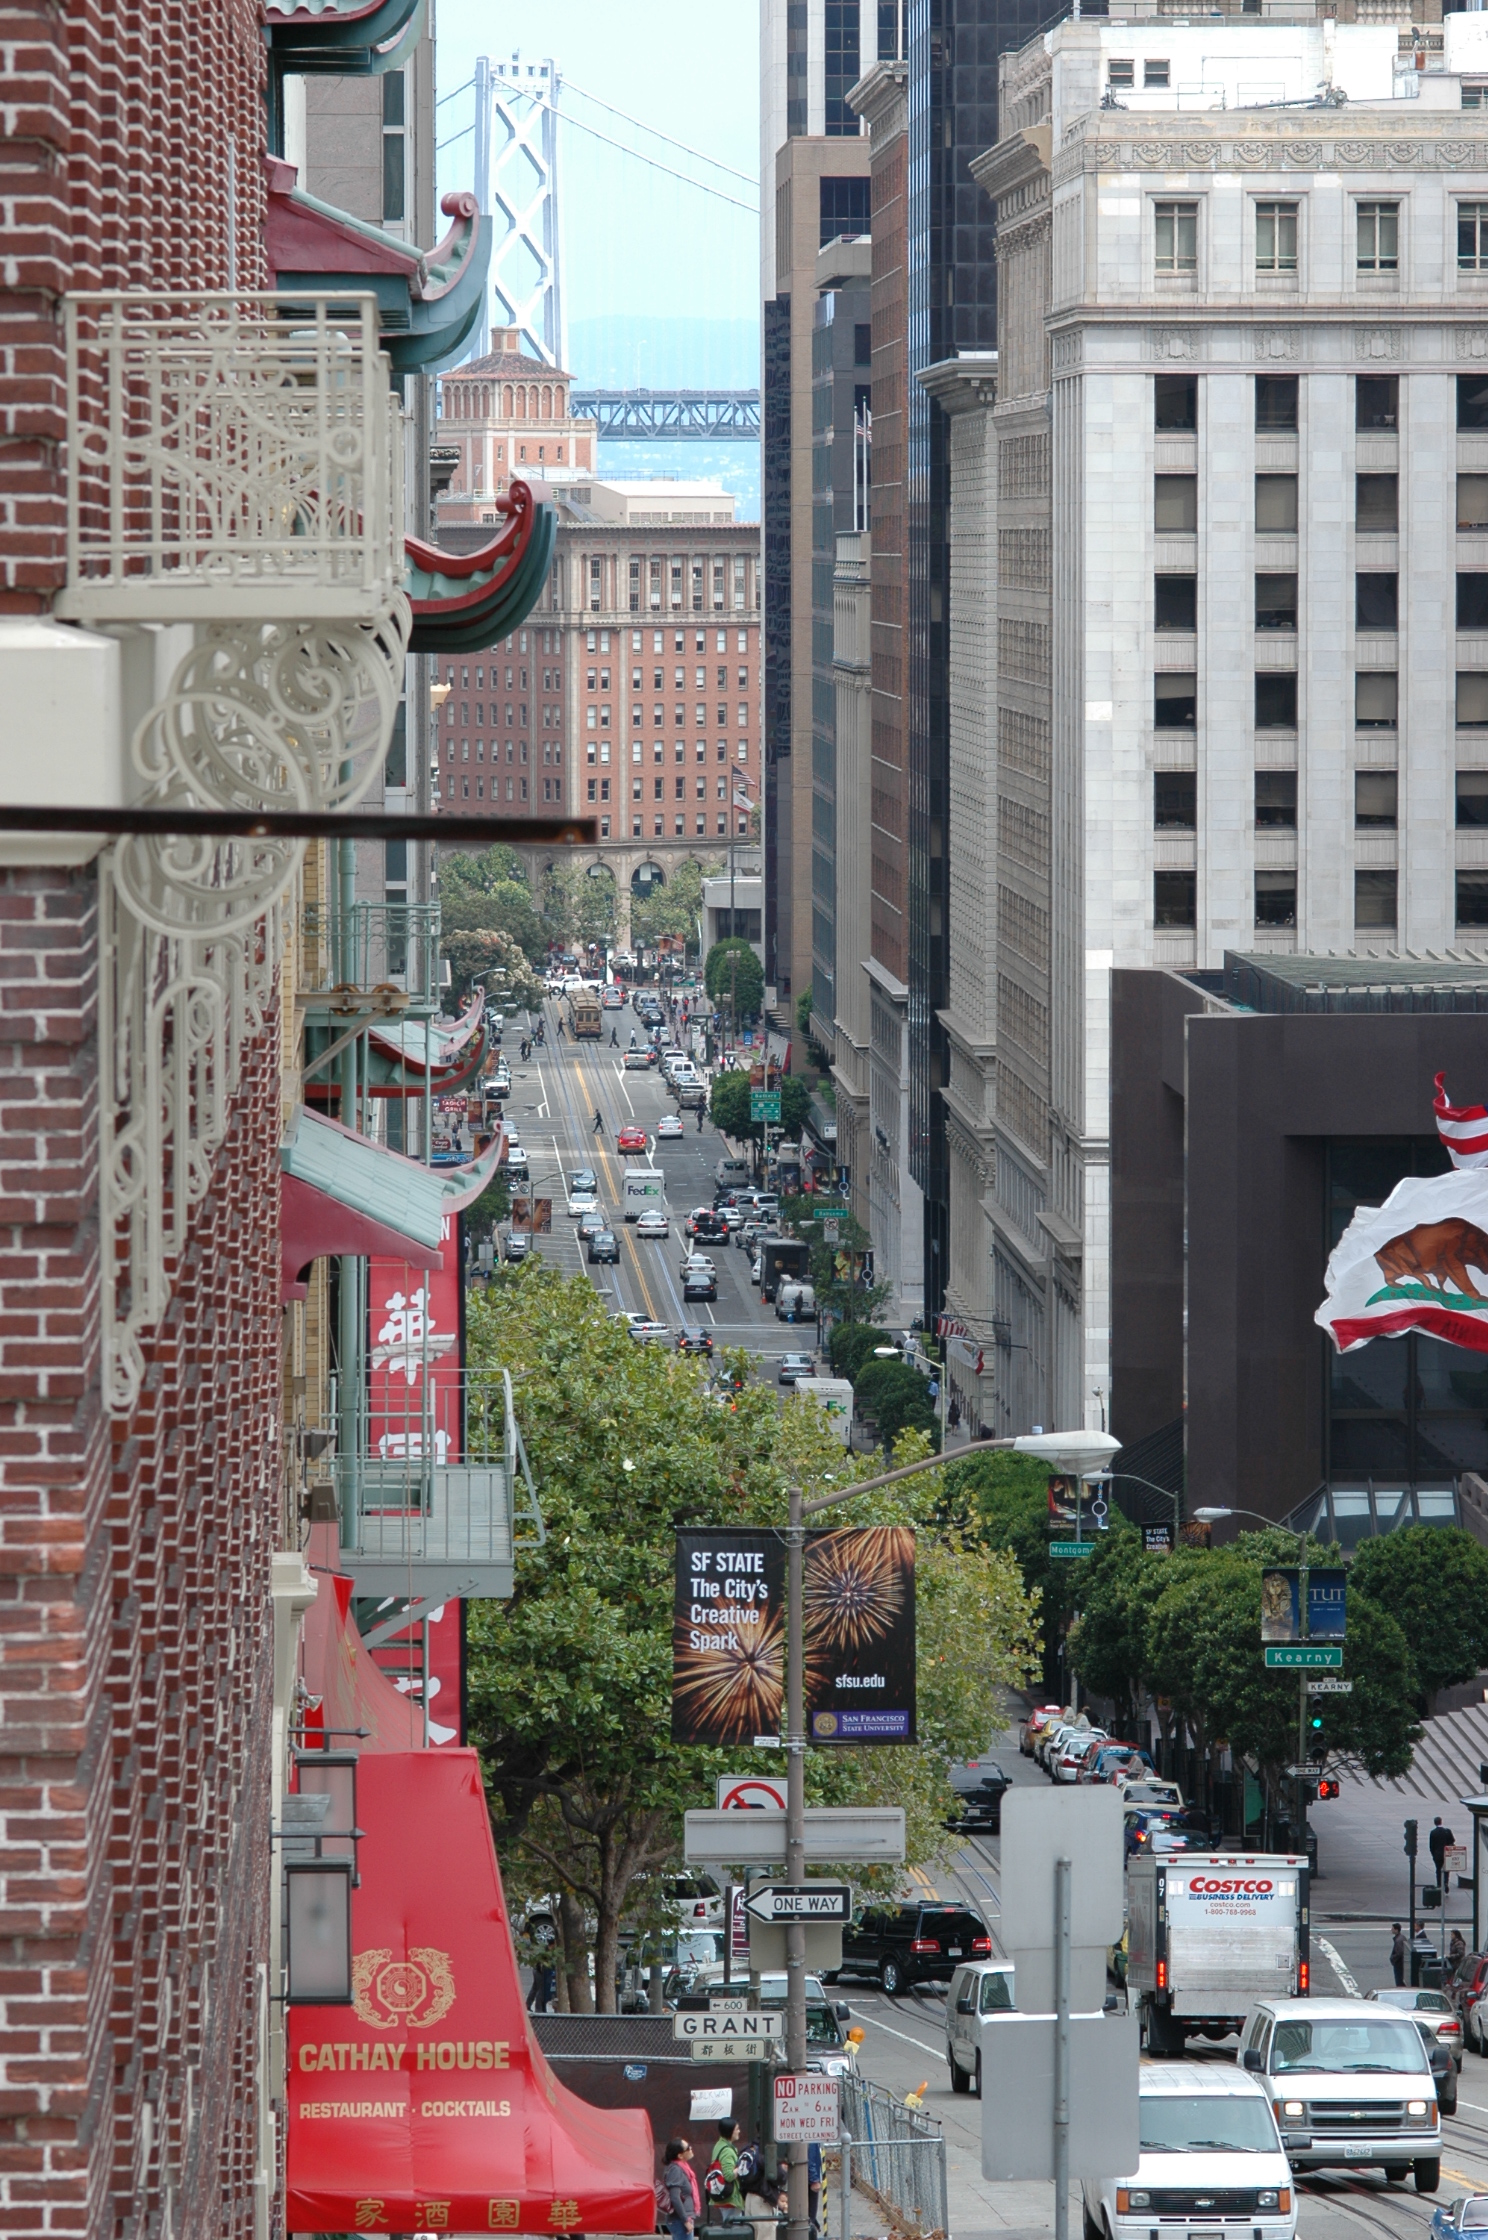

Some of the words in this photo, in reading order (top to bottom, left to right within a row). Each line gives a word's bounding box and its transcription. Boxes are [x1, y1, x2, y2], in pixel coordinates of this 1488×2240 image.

[628, 1185, 659, 1196] FedEx
[691, 1552, 712, 1571] SF
[716, 1552, 764, 1572] STATE
[690, 1578, 720, 1597] The
[724, 1578, 768, 1602] City's
[1310, 1588, 1345, 1600] TUT
[691, 1604, 759, 1624] Creative
[690, 1630, 738, 1652] Spark
[1274, 1652, 1332, 1664] Kearny
[835, 1673, 885, 1688] sfsu.edu
[1310, 1682, 1350, 1690] KEARNY
[1189, 1876, 1273, 1893] COSTCO
[773, 1897, 803, 1911] ONE
[808, 1897, 838, 1911] WAY
[724, 2001, 742, 2010] 600
[683, 2017, 775, 2034] GRANT
[299, 2043, 406, 2072] CATHAY
[416, 2041, 510, 2071] HOUSE
[701, 2043, 757, 2056] 都板街
[777, 2080, 795, 2097] NO
[798, 2082, 837, 2095] PARKING
[300, 2102, 407, 2119] RESTAURANT
[421, 2101, 511, 2117] COCKTAILS
[780, 2118, 796, 2128] MON
[799, 2117, 816, 2128] WED
[820, 2116, 835, 2127] FRI
[804, 2131, 836, 2139] CLEANING
